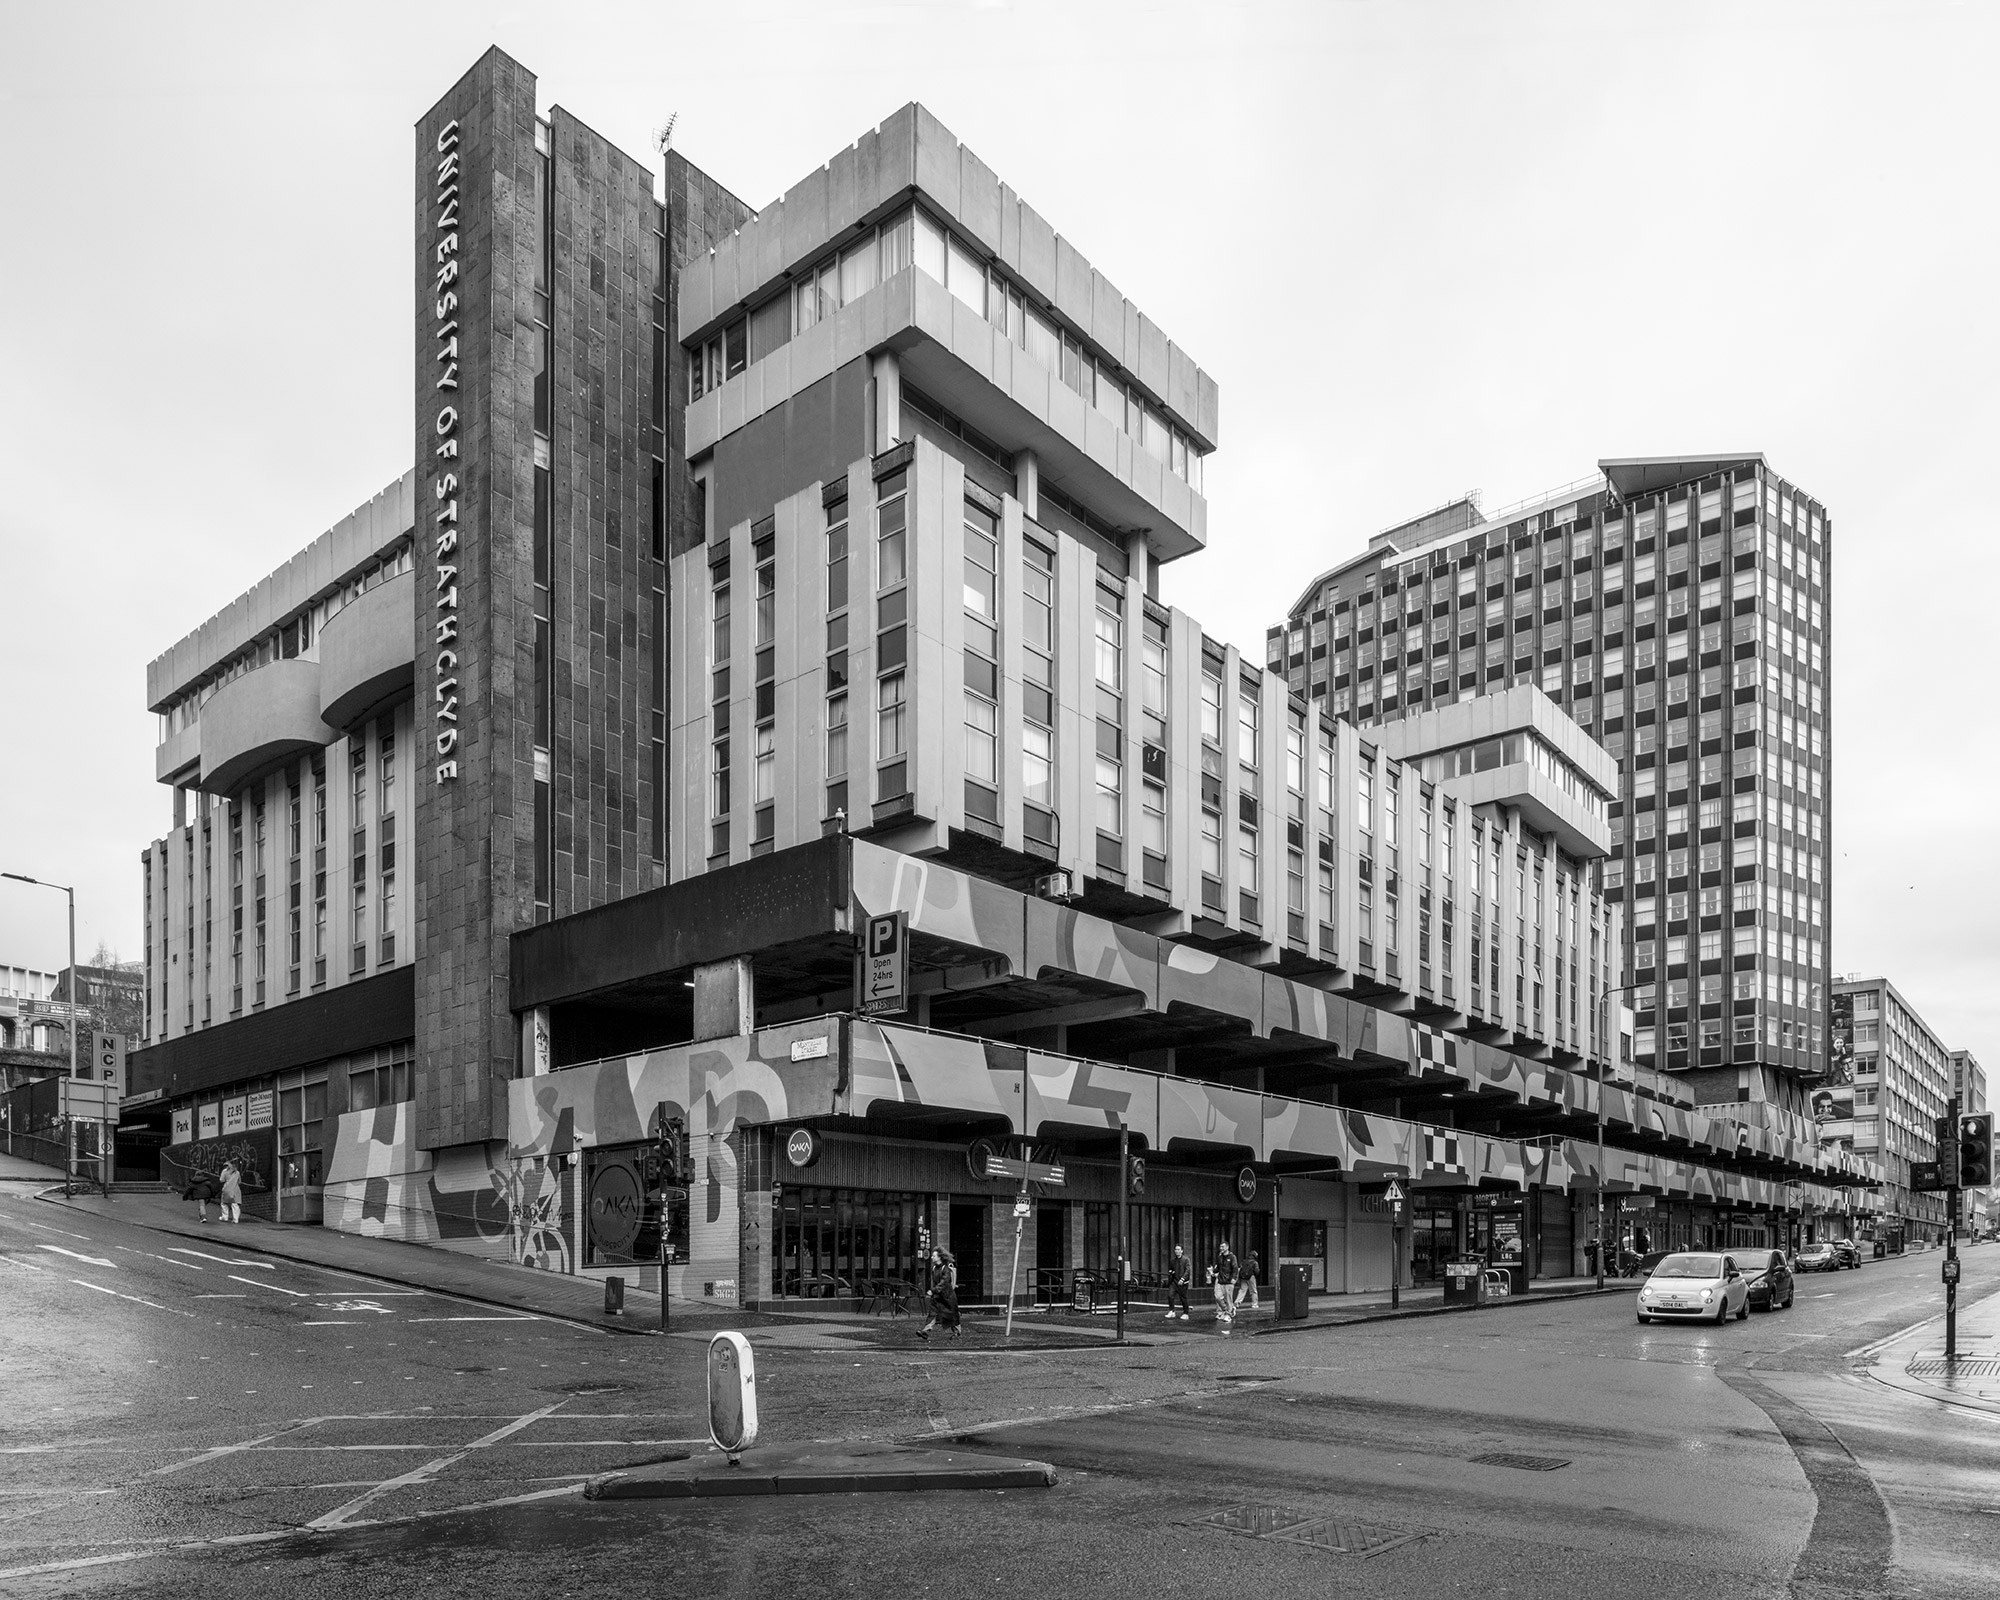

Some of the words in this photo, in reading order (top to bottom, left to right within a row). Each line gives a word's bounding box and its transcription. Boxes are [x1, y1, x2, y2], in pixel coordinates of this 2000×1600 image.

[437, 119, 459, 390] UNIVERSITY
[436, 405, 458, 458] OF
[436, 473, 457, 785] STRATHCLYDE
[874, 919, 893, 954] P
[873, 958, 891, 970] Open
[872, 970, 893, 982] 24hrs
[102, 1039, 114, 1081] NCP
[227, 1104, 242, 1117] £2.95
[176, 1120, 189, 1133] Park
[202, 1115, 216, 1127] from
[790, 1142, 810, 1152] OAKA
